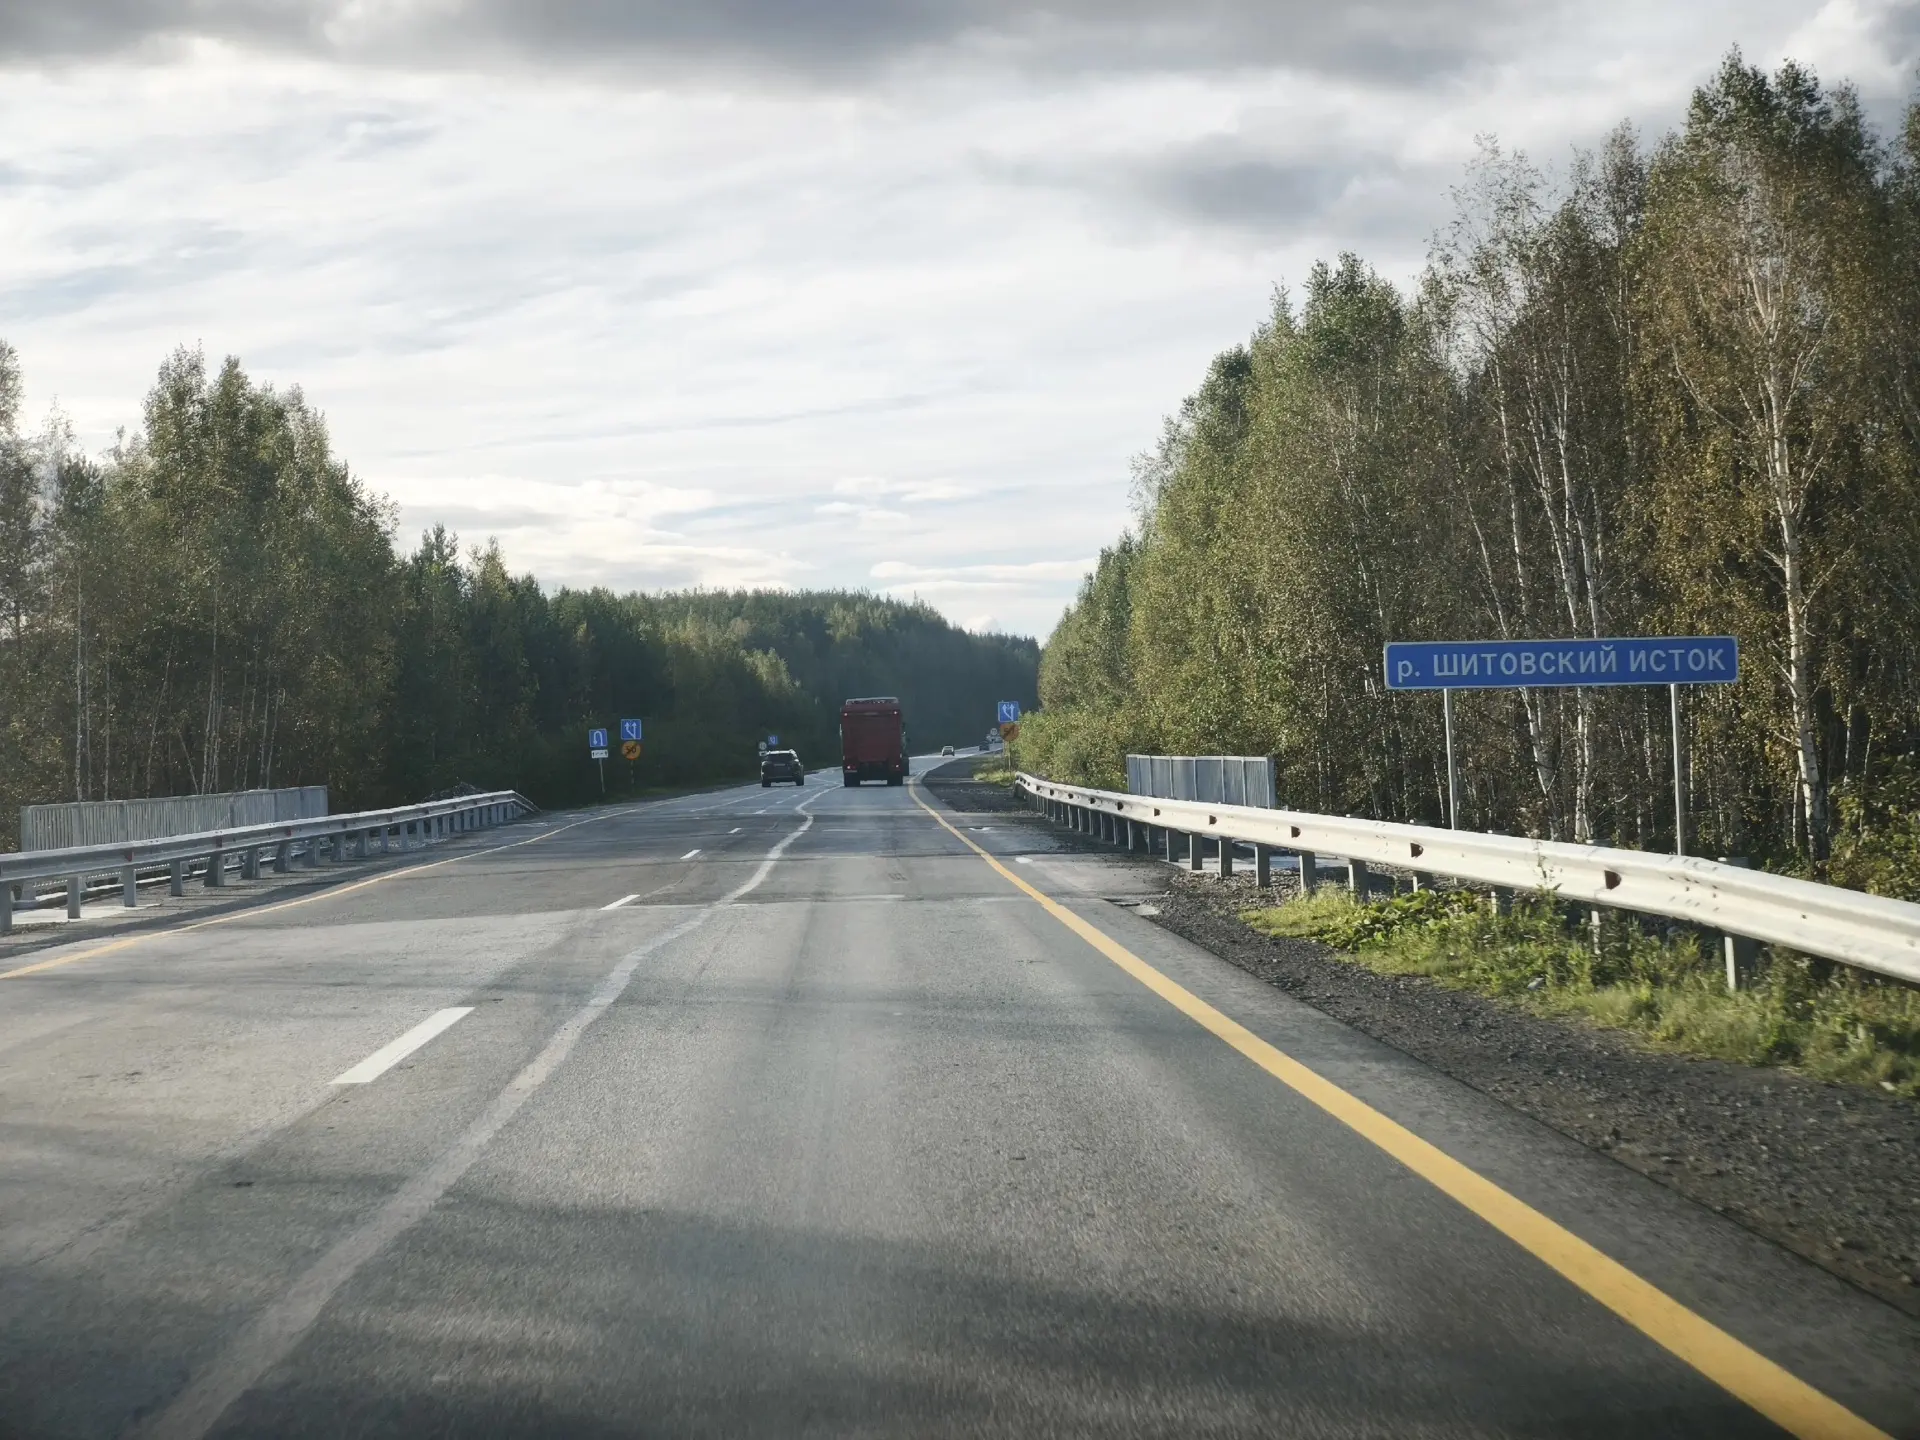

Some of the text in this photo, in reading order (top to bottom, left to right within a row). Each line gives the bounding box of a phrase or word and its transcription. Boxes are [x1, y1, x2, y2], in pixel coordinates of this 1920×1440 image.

[1397, 645, 1725, 683] р. ШИТОВСКИЙ ИСТОК
